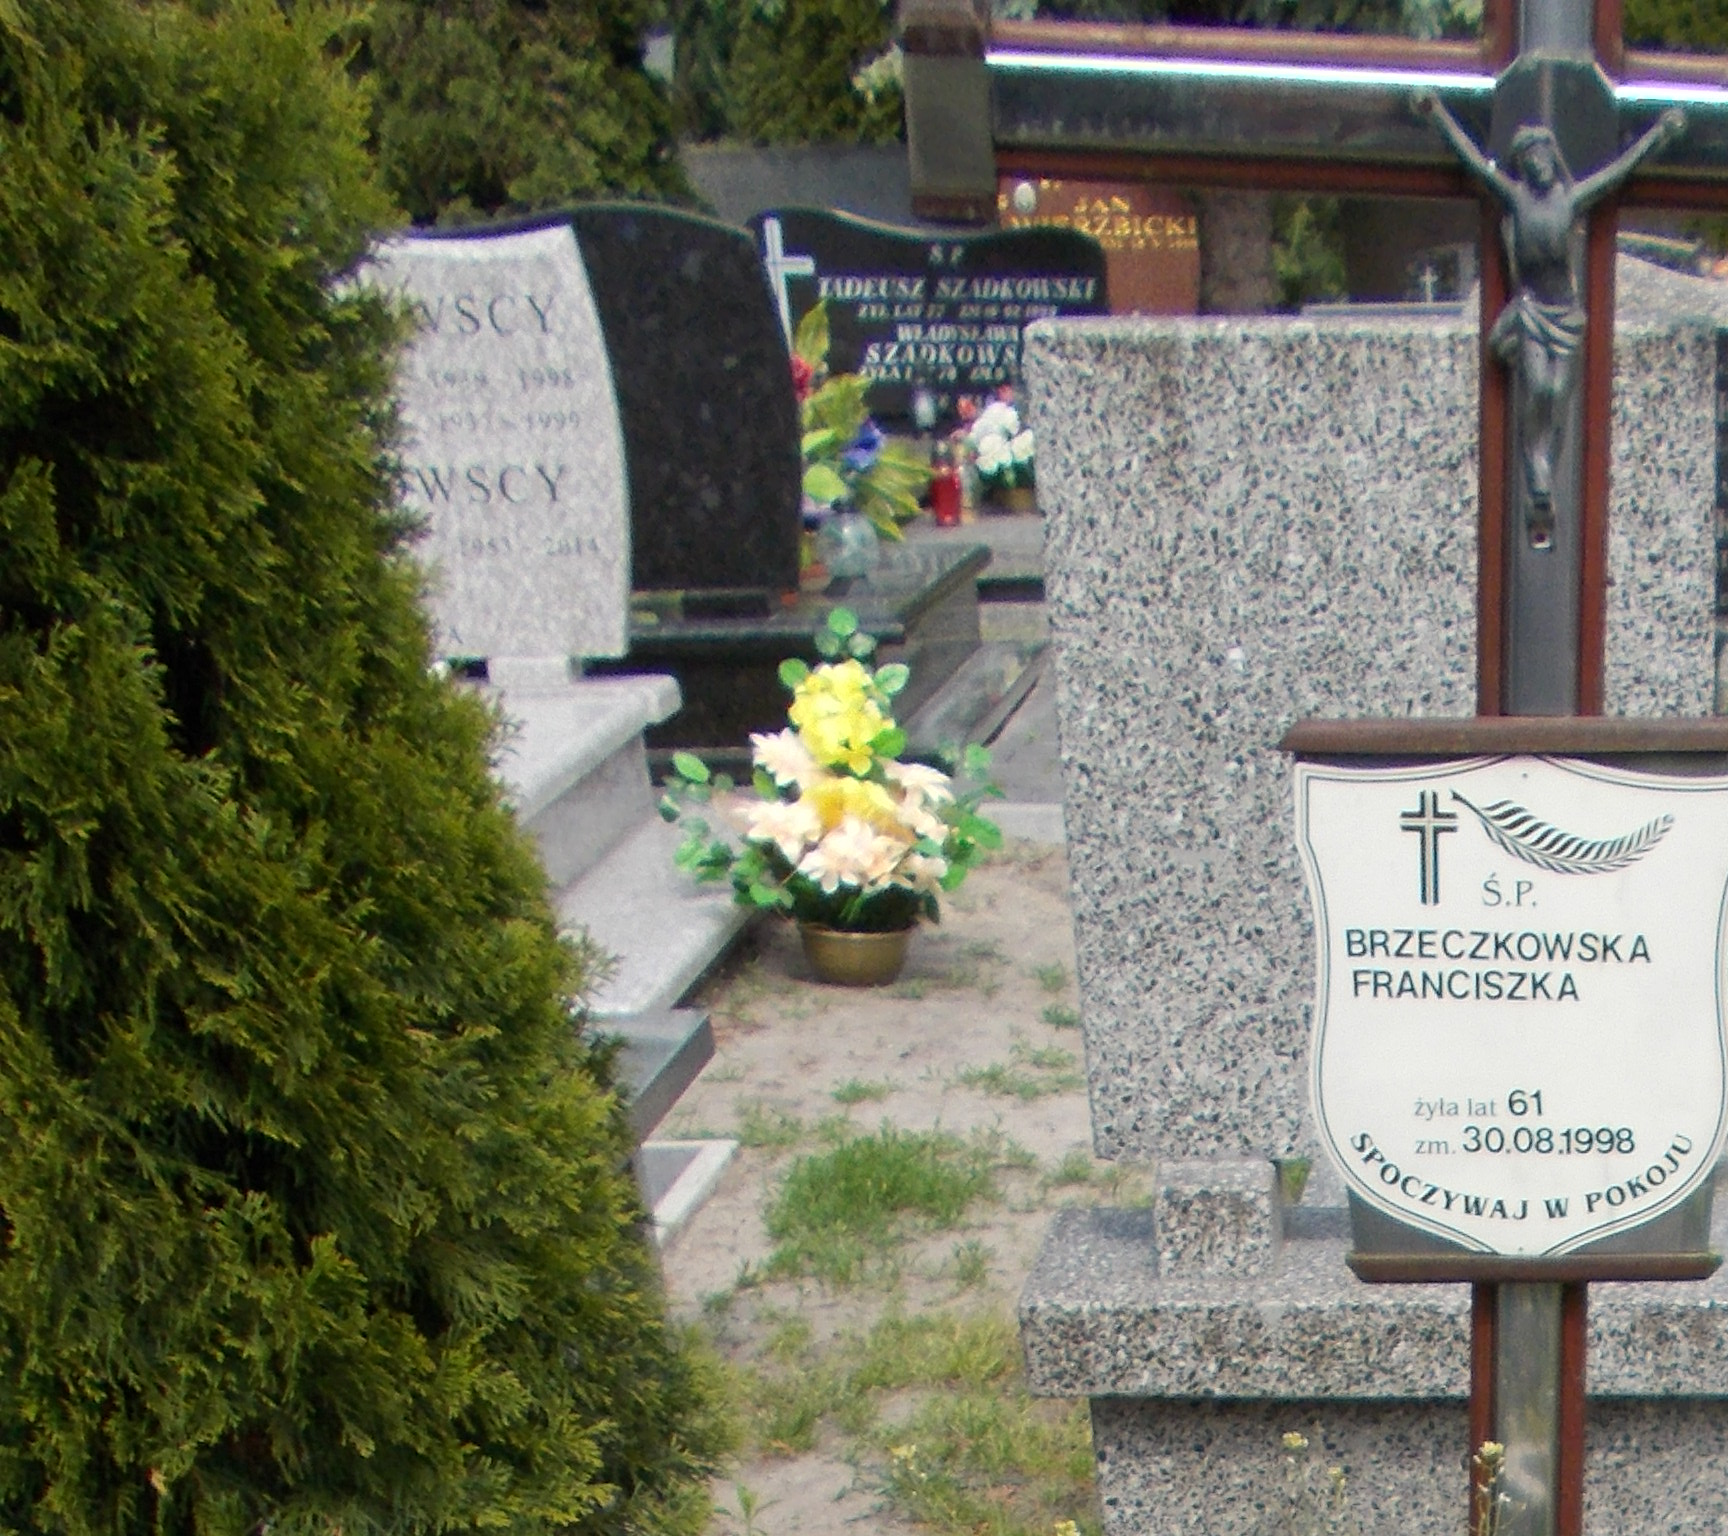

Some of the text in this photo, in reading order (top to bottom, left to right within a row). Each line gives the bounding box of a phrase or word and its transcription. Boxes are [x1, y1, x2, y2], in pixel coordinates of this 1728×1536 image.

[819, 276, 1097, 300] TADEUSZ SZADKOWSKI
[1482, 872, 1537, 907] Ś.P.
[1345, 929, 1651, 963] BRZECZKOWSKA
[1352, 969, 1579, 1002] FRANCISZKA
[1467, 1098, 1497, 1117] lat
[1507, 1089, 1544, 1117] 61
[1415, 1126, 1636, 1155] zm. 30.08.1998
[1350, 1132, 1693, 1221] SPOCZYWAJ W POKOJU
